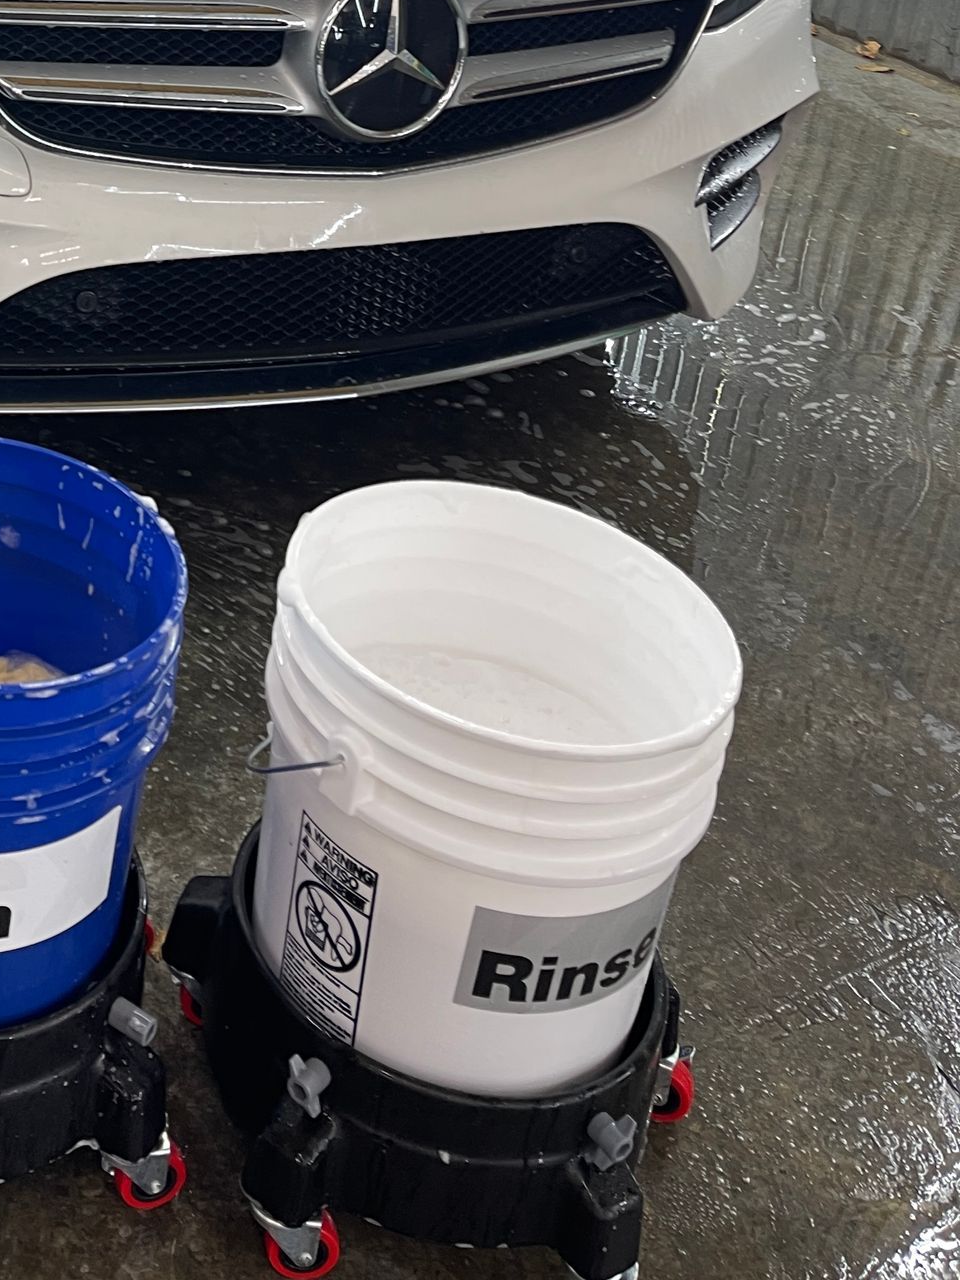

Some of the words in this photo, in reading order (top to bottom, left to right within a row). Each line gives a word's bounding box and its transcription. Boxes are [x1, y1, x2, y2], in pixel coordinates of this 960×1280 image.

[314, 828, 375, 888] WARNING
[321, 855, 359, 891] AVISO
[472, 926, 657, 1003] Rinse
